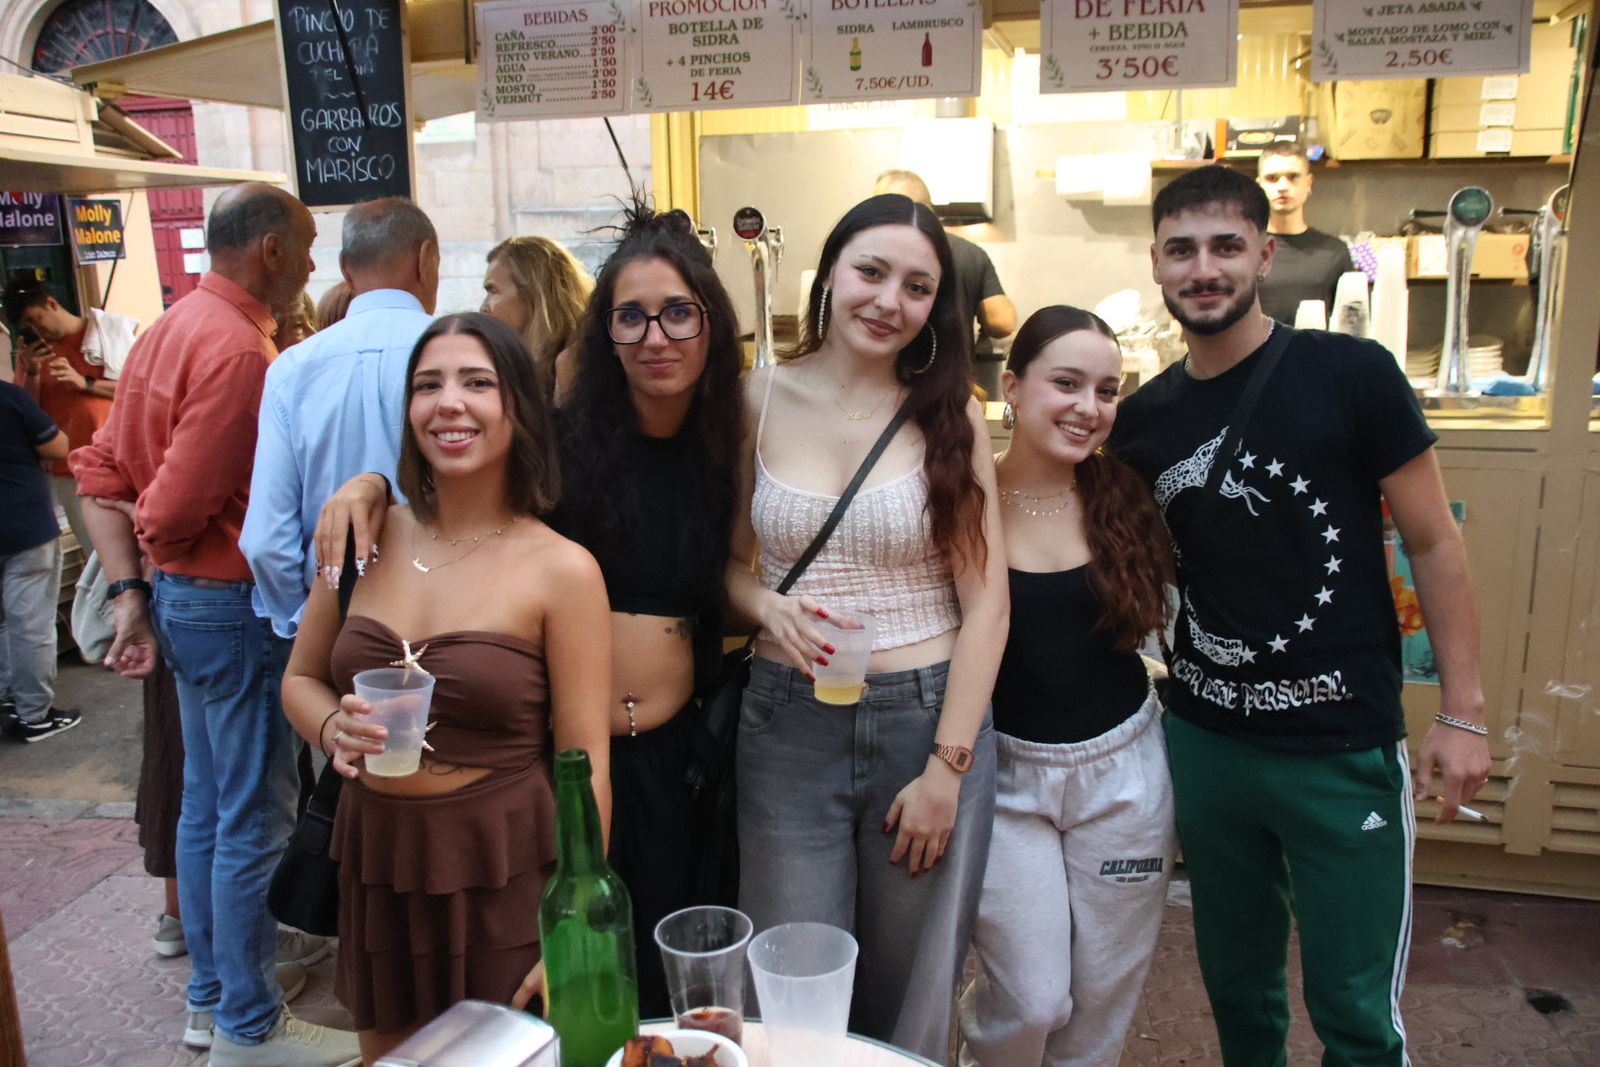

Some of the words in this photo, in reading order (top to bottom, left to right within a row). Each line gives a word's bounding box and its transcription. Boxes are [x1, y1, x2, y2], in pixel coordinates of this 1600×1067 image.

[1074, 0, 1112, 19] DE
[1123, 0, 1205, 17] FERIA
[1377, 5, 1414, 16] JETA
[1418, 1, 1467, 13] ASADA
[365, 8, 389, 29] DE
[523, 9, 589, 26] BEBIDAS
[668, 19, 738, 35] BOTELLA
[742, 17, 764, 30] DE
[836, 24, 875, 35] SIDRA
[892, 17, 964, 31] LAMBRUSCO
[495, 29, 526, 42] CAÑA
[1109, 21, 1189, 41] BEBIDA
[1347, 25, 1409, 36] MONTADO
[1412, 24, 1429, 34] DE
[1433, 22, 1470, 32] LOMO
[1473, 20, 1500, 30] CON
[496, 39, 556, 53] REFRESCO
[692, 33, 740, 47] SIDRA
[1347, 36, 1385, 47] SALSA
[1389, 33, 1448, 45] MOSTAZA
[1451, 32, 1460, 42] Y
[1464, 30, 1496, 41] MIEL
[496, 52, 529, 63] TINTO
[533, 48, 580, 60] VERANO
[678, 56, 686, 67] 4
[690, 51, 751, 65] PINCHOS
[1385, 48, 1454, 69] 2,50€
[496, 63, 526, 74] AGUA
[690, 68, 706, 78] DE
[708, 66, 742, 77] FERIA
[496, 74, 523, 84] VINO
[690, 80, 735, 101] 14€
[328, 136, 362, 153] CON
[306, 152, 396, 184] MARISCO
[75, 204, 112, 226] Molly
[75, 227, 121, 245] Malone
[1361, 820, 1387, 831] adidas
